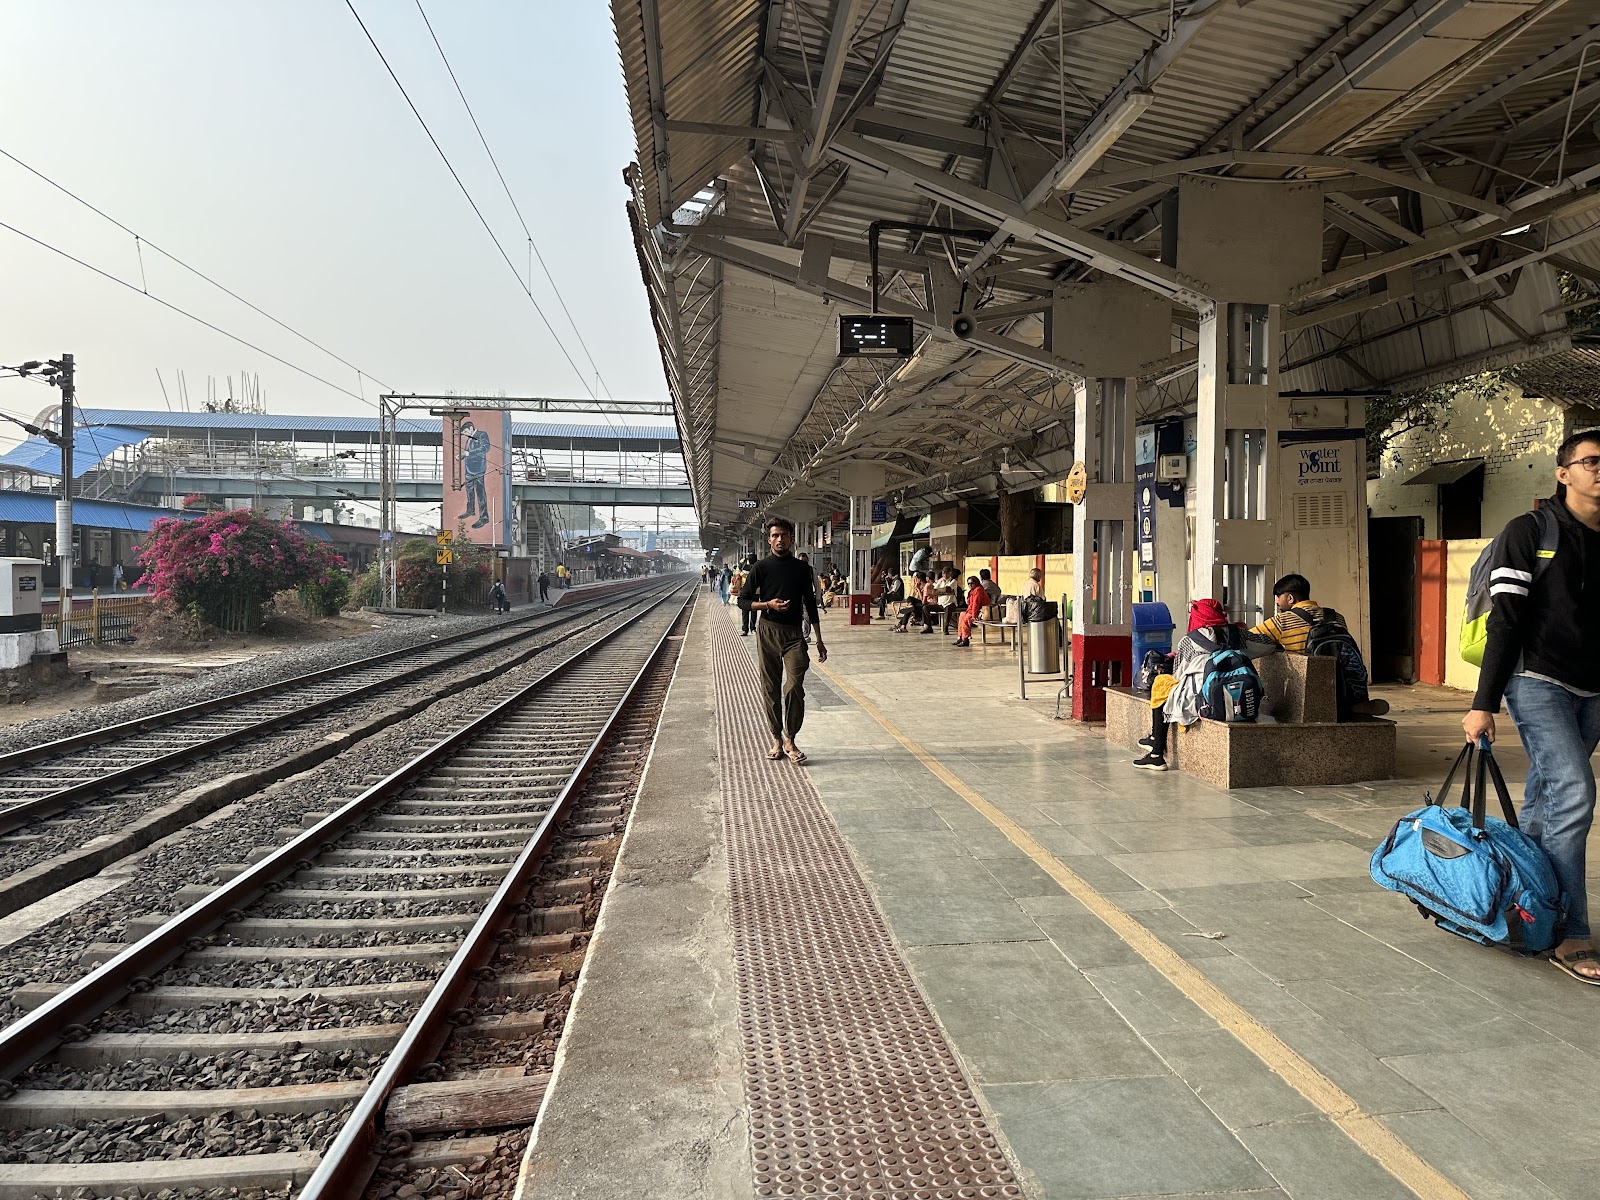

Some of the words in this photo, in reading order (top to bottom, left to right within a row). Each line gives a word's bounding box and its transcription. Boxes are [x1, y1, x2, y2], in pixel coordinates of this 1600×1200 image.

[1299, 447, 1340, 459] water
[1298, 458, 1342, 477] point
[1245, 688, 1255, 718] HILFIGER
